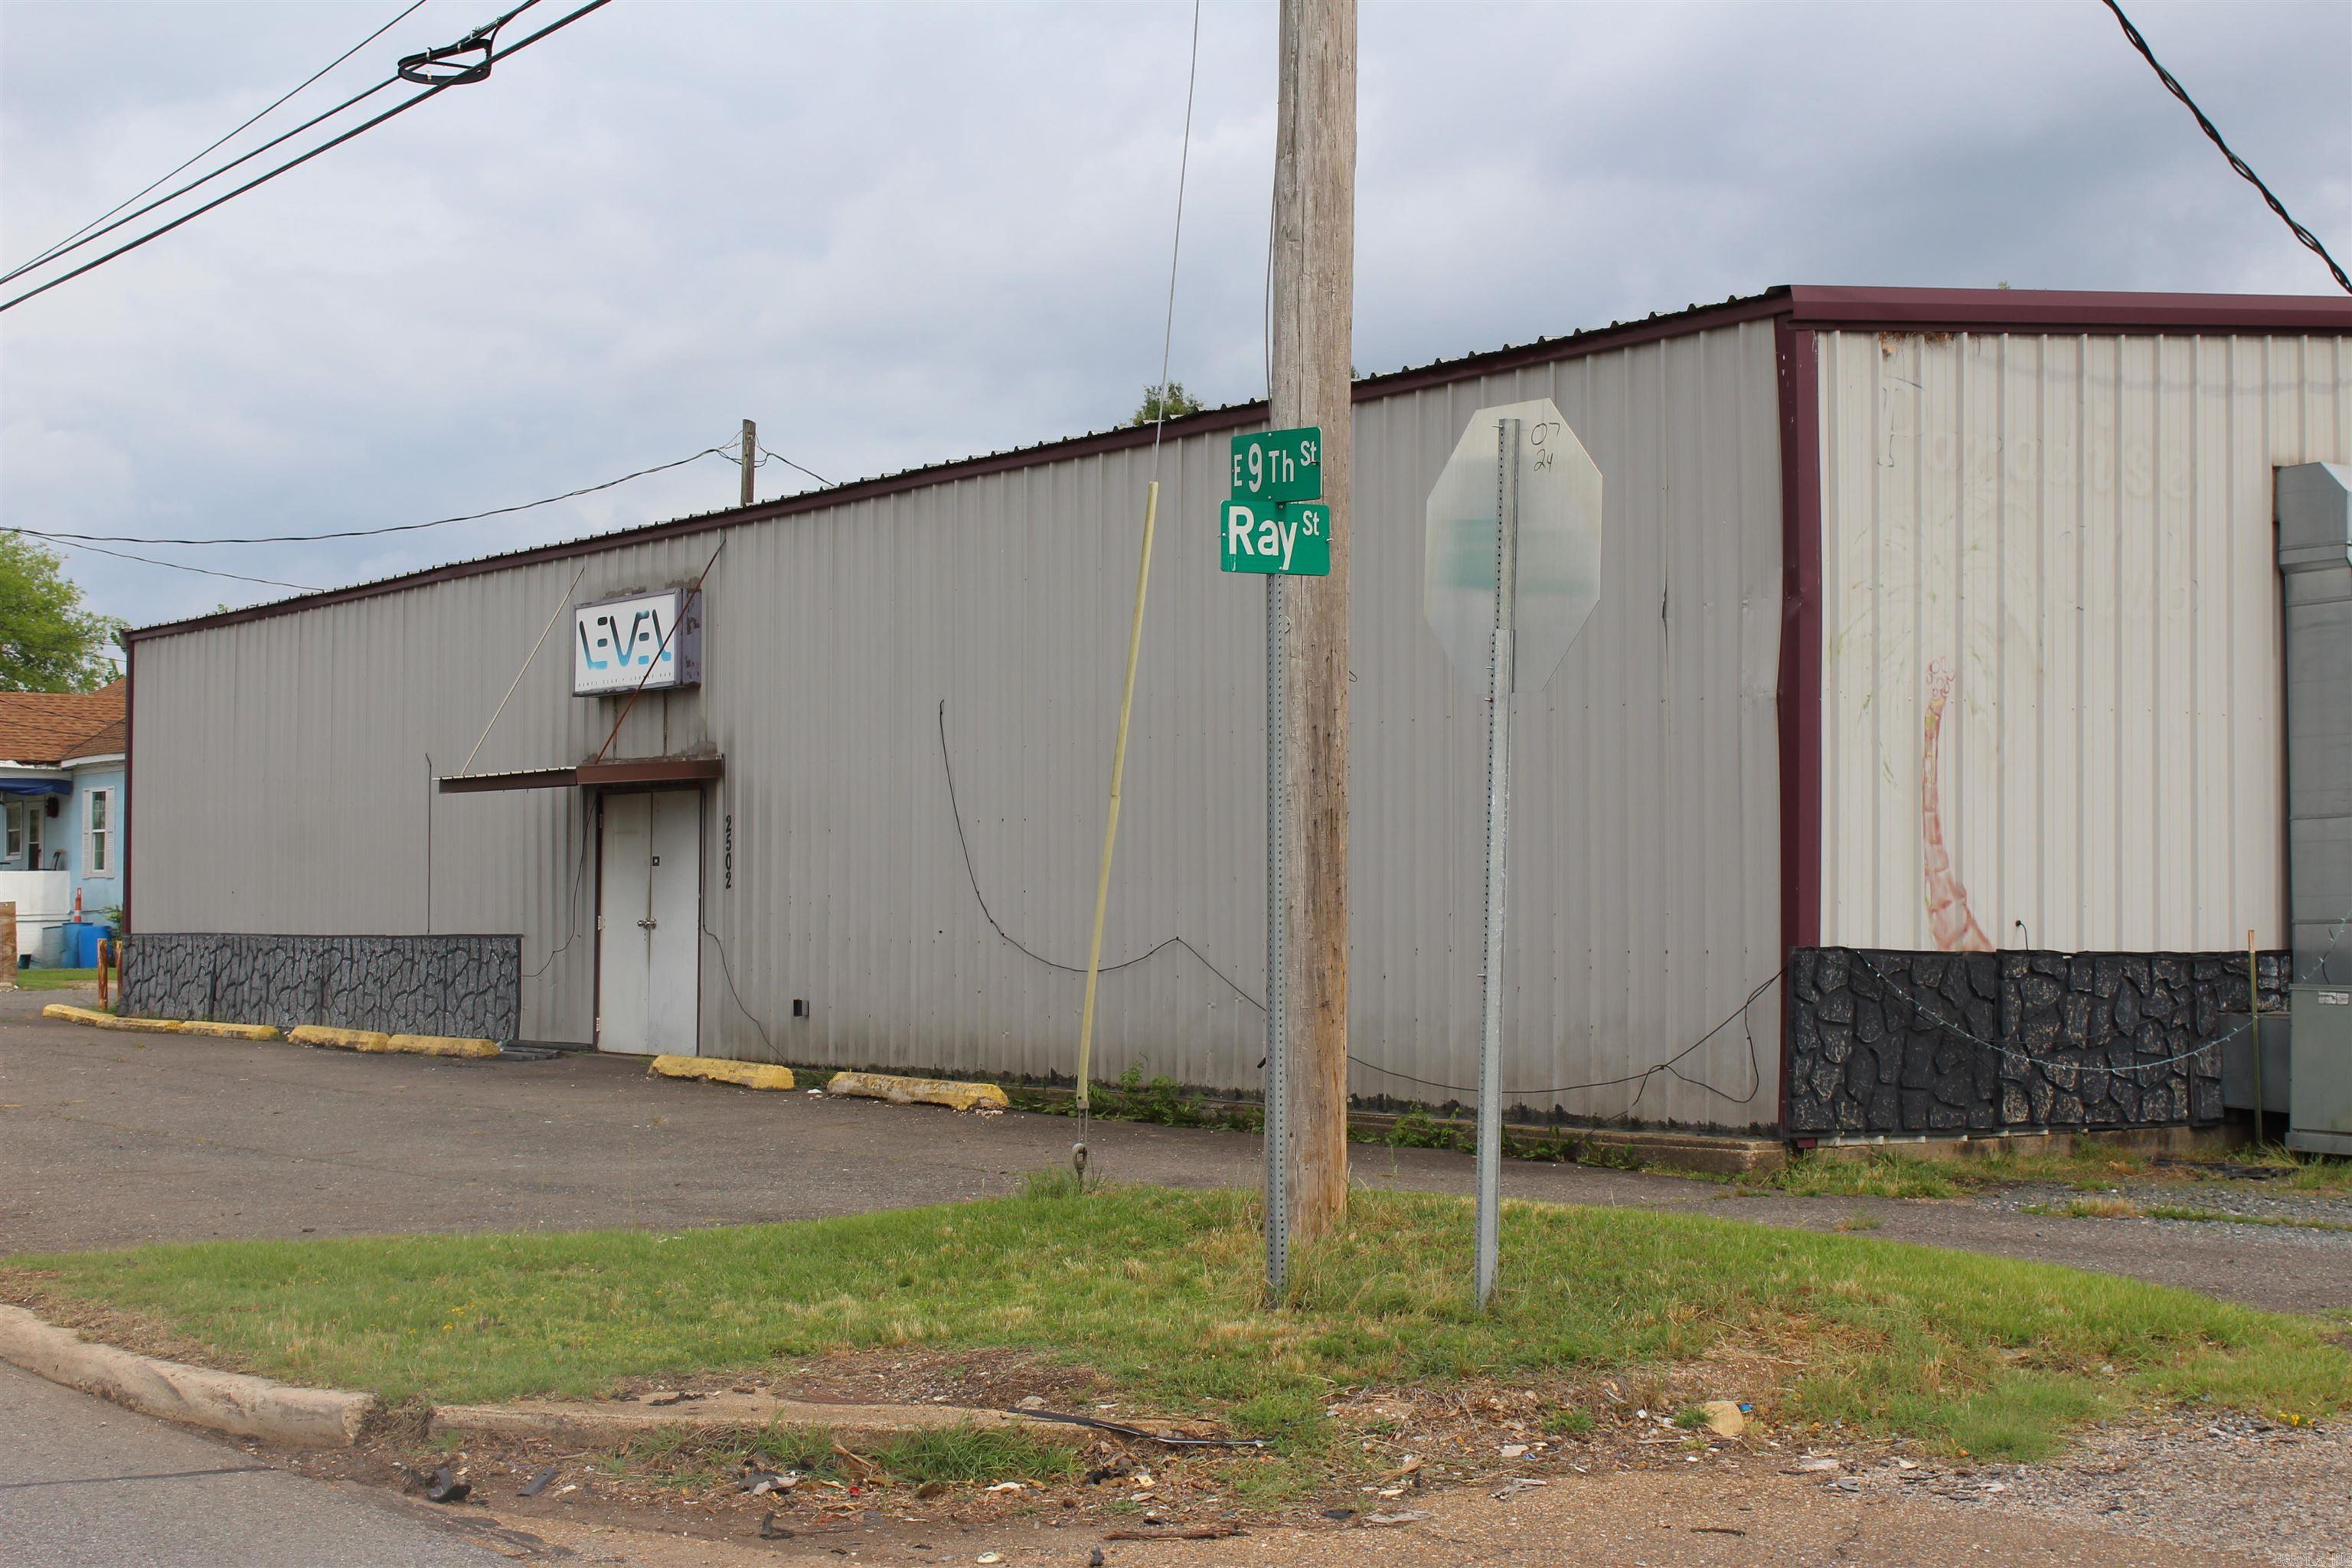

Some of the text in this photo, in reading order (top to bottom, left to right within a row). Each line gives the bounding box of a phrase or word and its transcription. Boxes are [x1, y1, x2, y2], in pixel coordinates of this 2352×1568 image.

[1531, 423, 1560, 446] 07
[1233, 440, 1317, 493] E 9Th St
[1534, 449, 1553, 474] 24
[1229, 505, 1320, 570] Ray St
[579, 609, 672, 671] LEVEL
